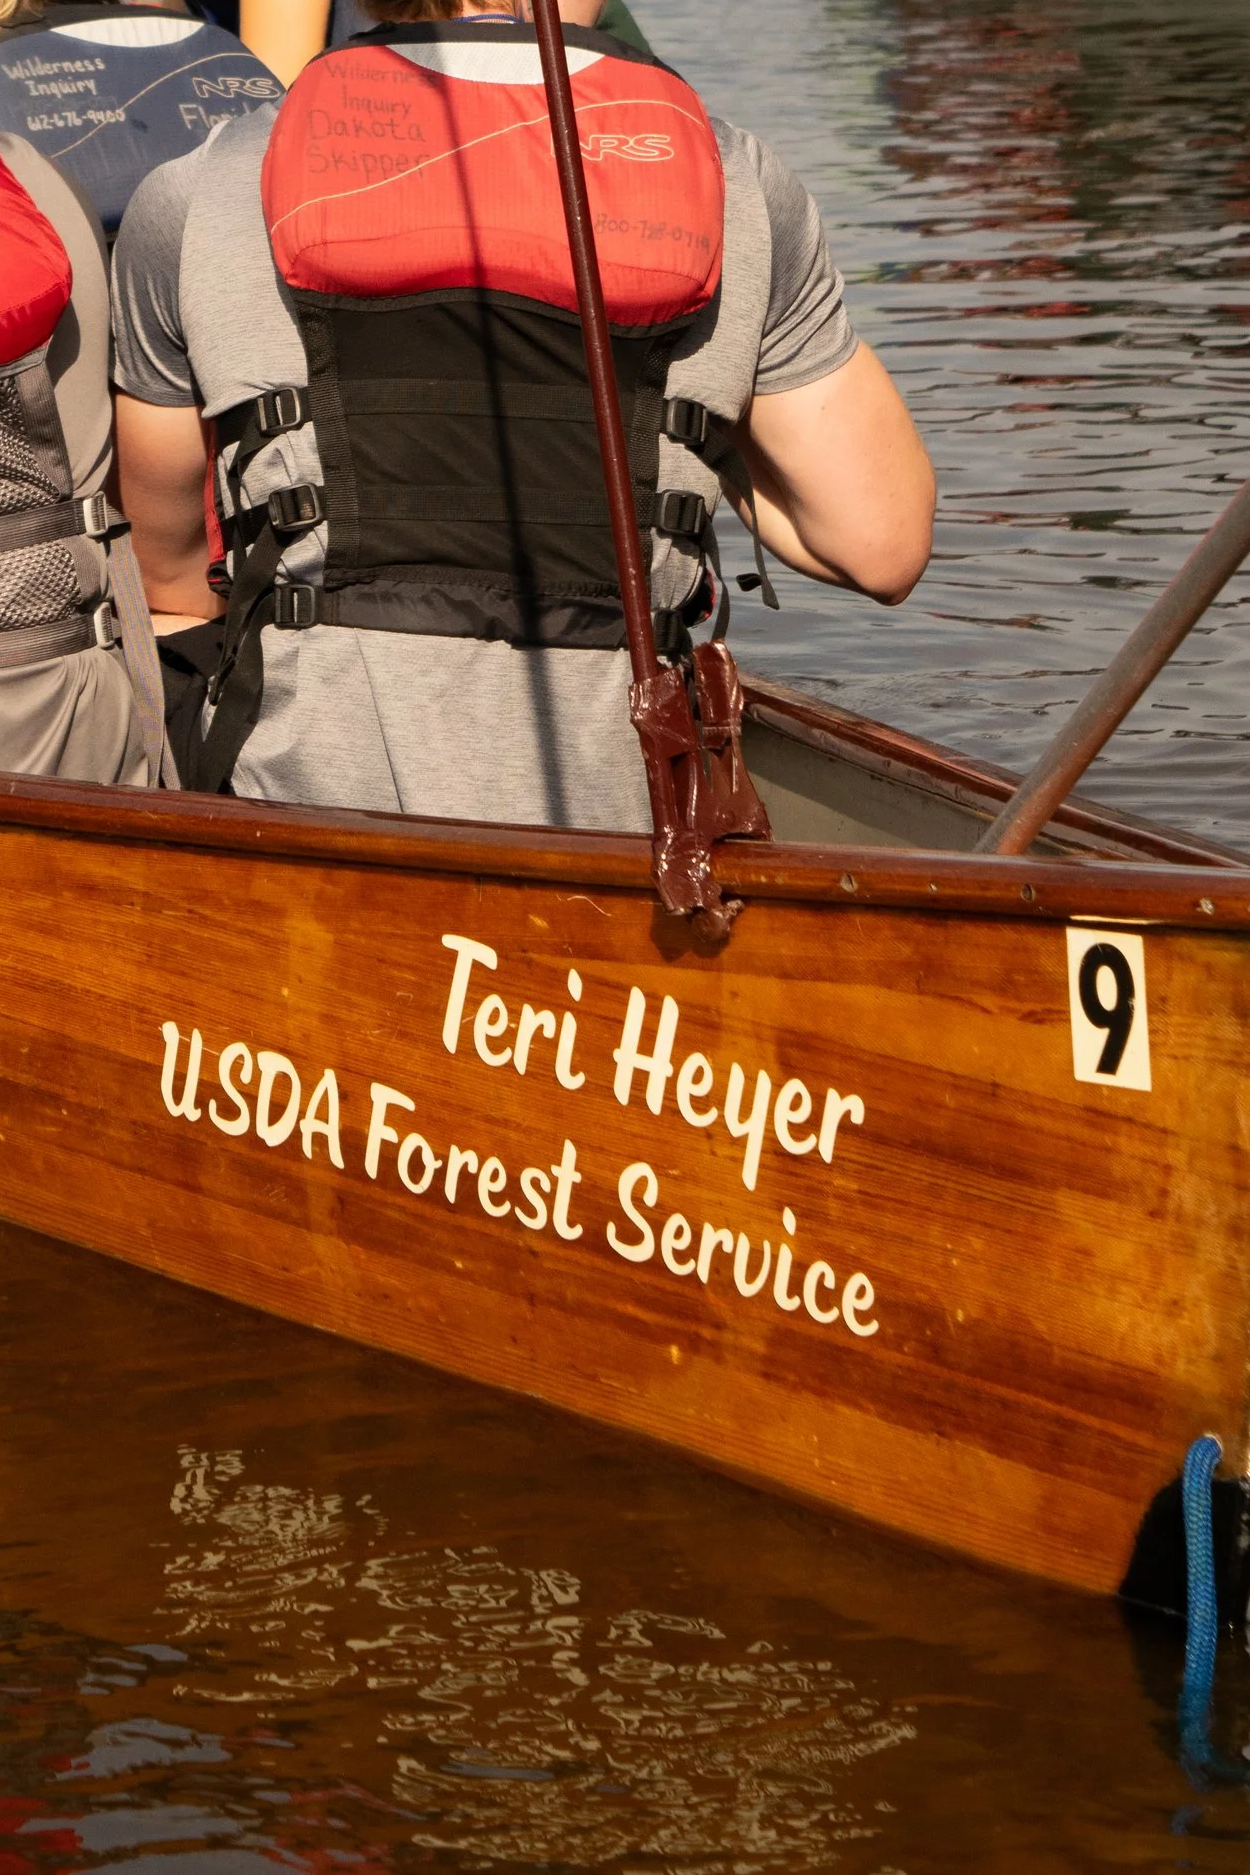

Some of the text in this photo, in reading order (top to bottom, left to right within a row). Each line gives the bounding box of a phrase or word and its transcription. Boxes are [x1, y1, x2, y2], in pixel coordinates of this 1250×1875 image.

[1, 56, 106, 80] Wilderness
[24, 76, 97, 99] Inquiry
[192, 77, 281, 98] NRS
[341, 83, 412, 121] Inquiry
[306, 109, 426, 143] Dakota
[306, 143, 430, 184] Skipper
[1078, 942, 1136, 1077] 9
[441, 934, 866, 1192] Teri Heyer
[160, 1021, 880, 1338] USDA Forest Service
